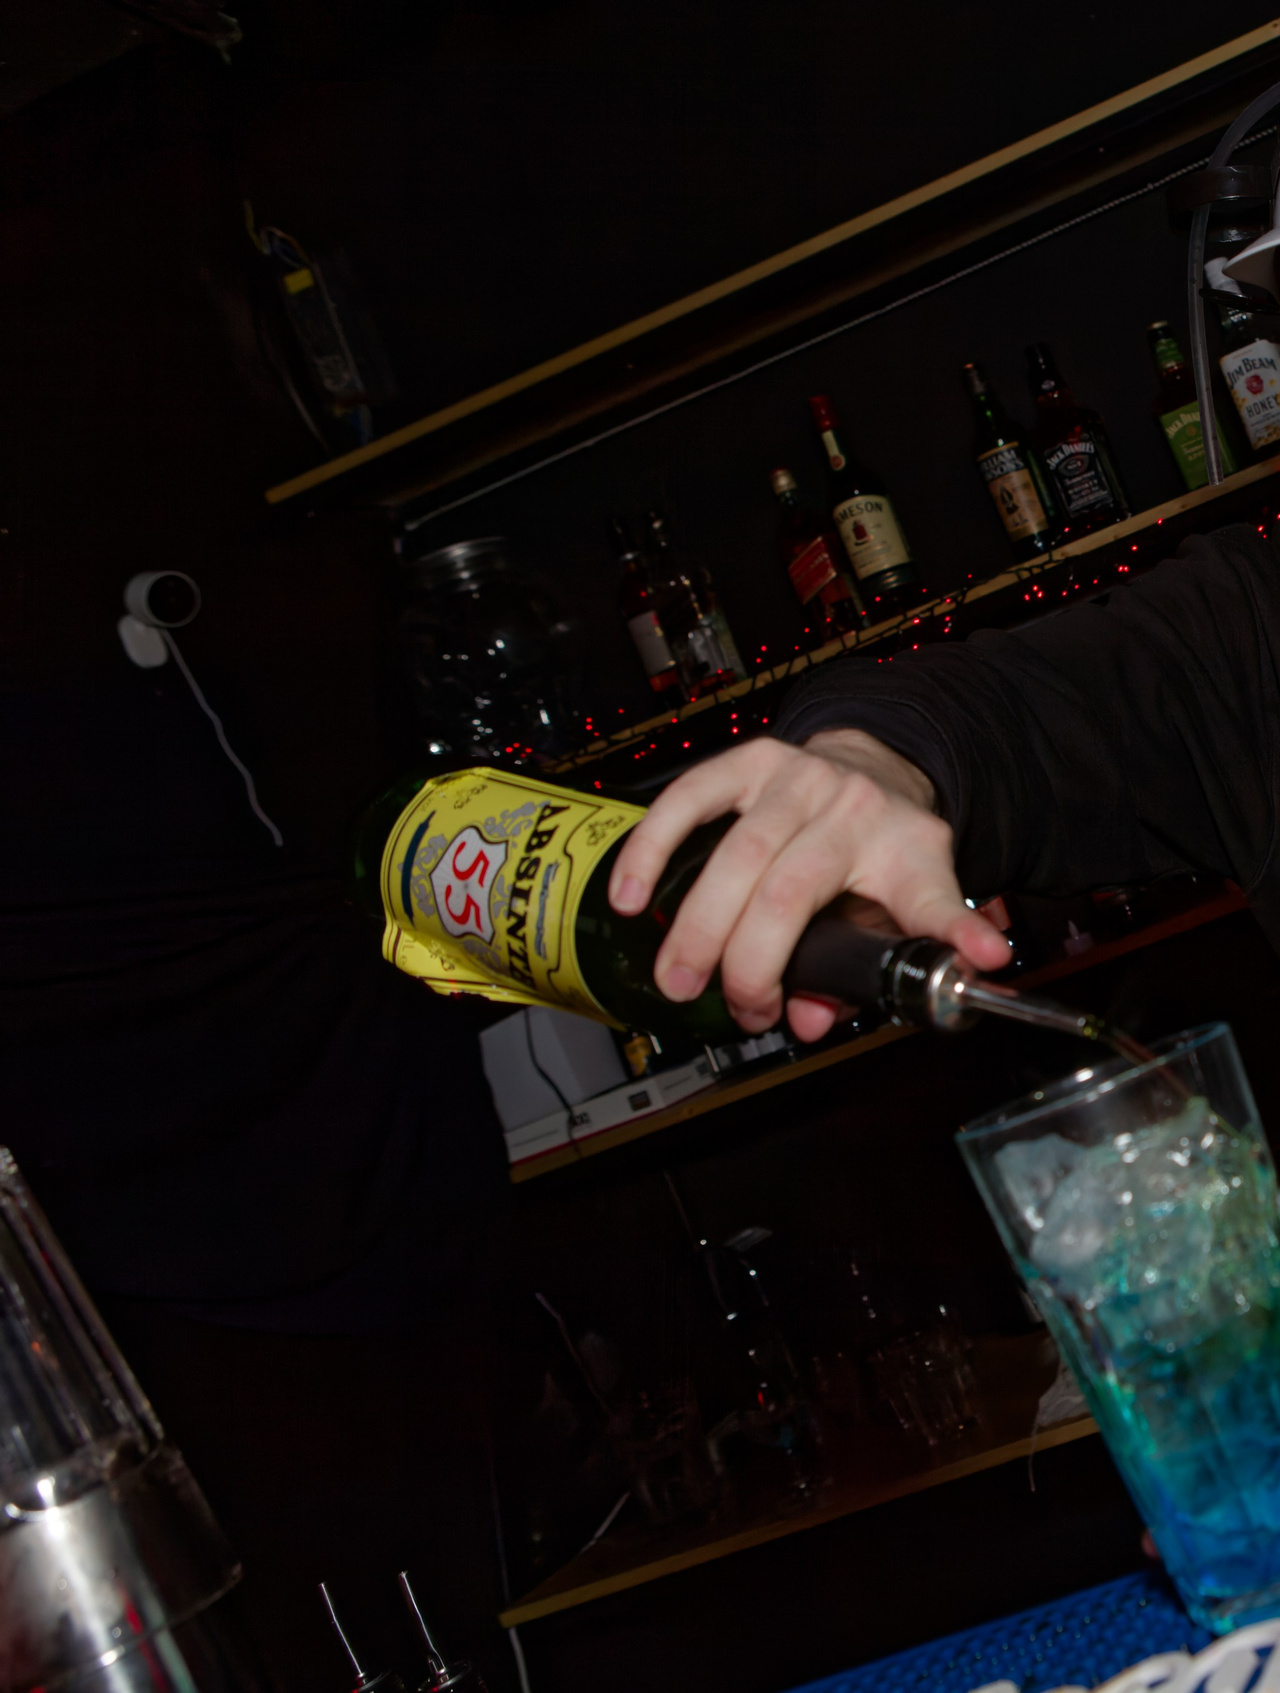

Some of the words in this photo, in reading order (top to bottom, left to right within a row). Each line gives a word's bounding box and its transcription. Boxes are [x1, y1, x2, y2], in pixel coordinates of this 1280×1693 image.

[1226, 366, 1245, 391] JIM
[1242, 356, 1278, 371] BEAM
[1245, 393, 1280, 419] HONEY
[445, 842, 489, 934] 55
